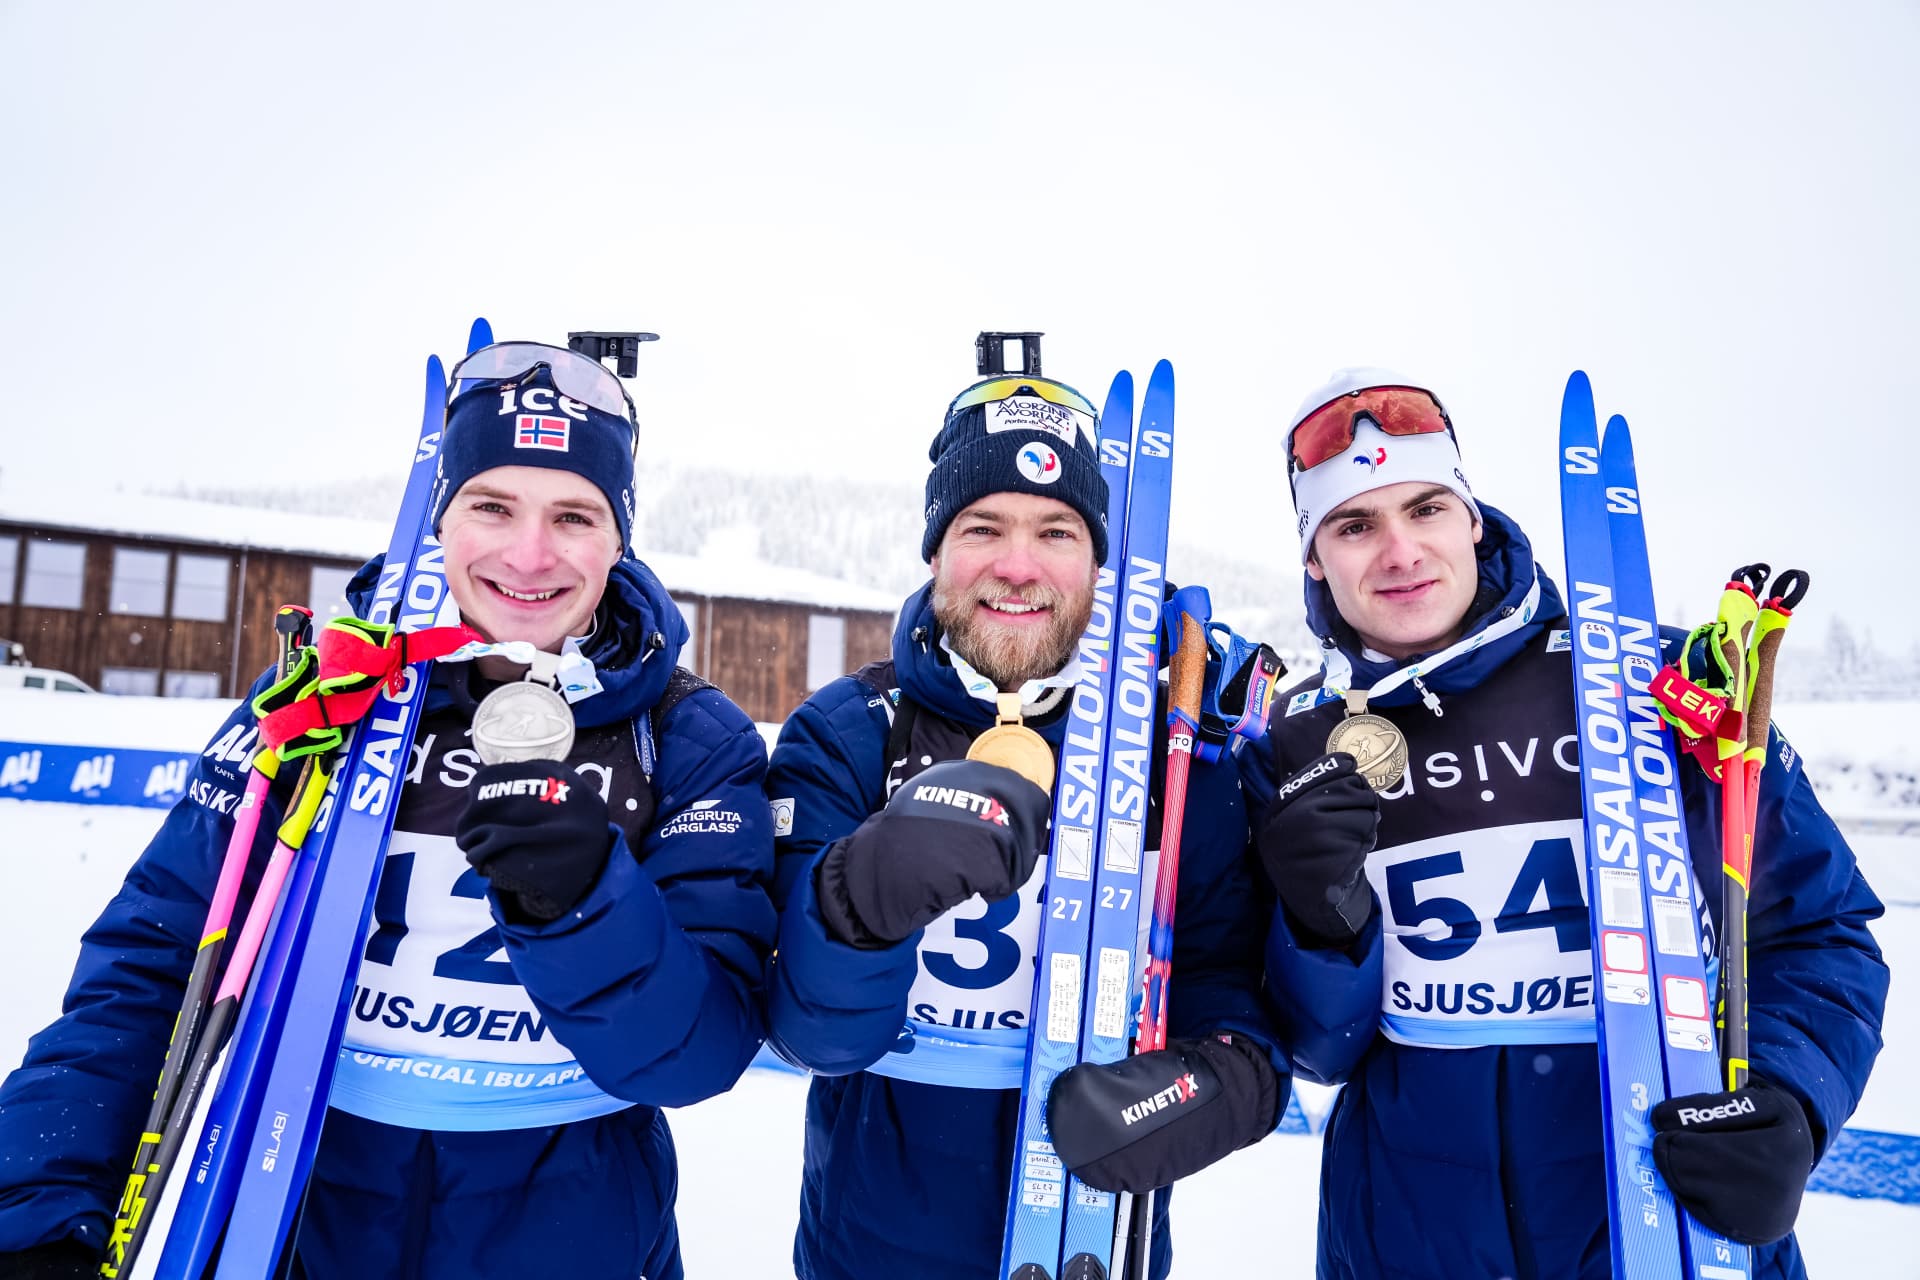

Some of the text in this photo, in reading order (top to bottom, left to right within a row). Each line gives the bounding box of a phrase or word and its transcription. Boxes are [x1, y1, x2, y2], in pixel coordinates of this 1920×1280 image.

[499, 383, 589, 422] ice
[996, 406, 1065, 429] AVORIAZ
[998, 399, 1070, 421] MORZINE
[1630, 657, 1650, 667] 254
[1061, 568, 1117, 826] SALOMON
[1107, 555, 1163, 821] SALOMON
[1253, 678, 1265, 715] SALOMON
[1662, 677, 1722, 723] LEKI
[1575, 581, 1640, 869] SALOMON
[1618, 615, 1691, 900] SALOMON
[1052, 896, 1083, 921] 27
[1101, 885, 1133, 910] 27
[1386, 837, 1592, 961] 54
[1391, 975, 1596, 1015] SJUSJØE
[353, 1052, 478, 1086] OFFICIAL
[483, 1070, 535, 1088] IBU
